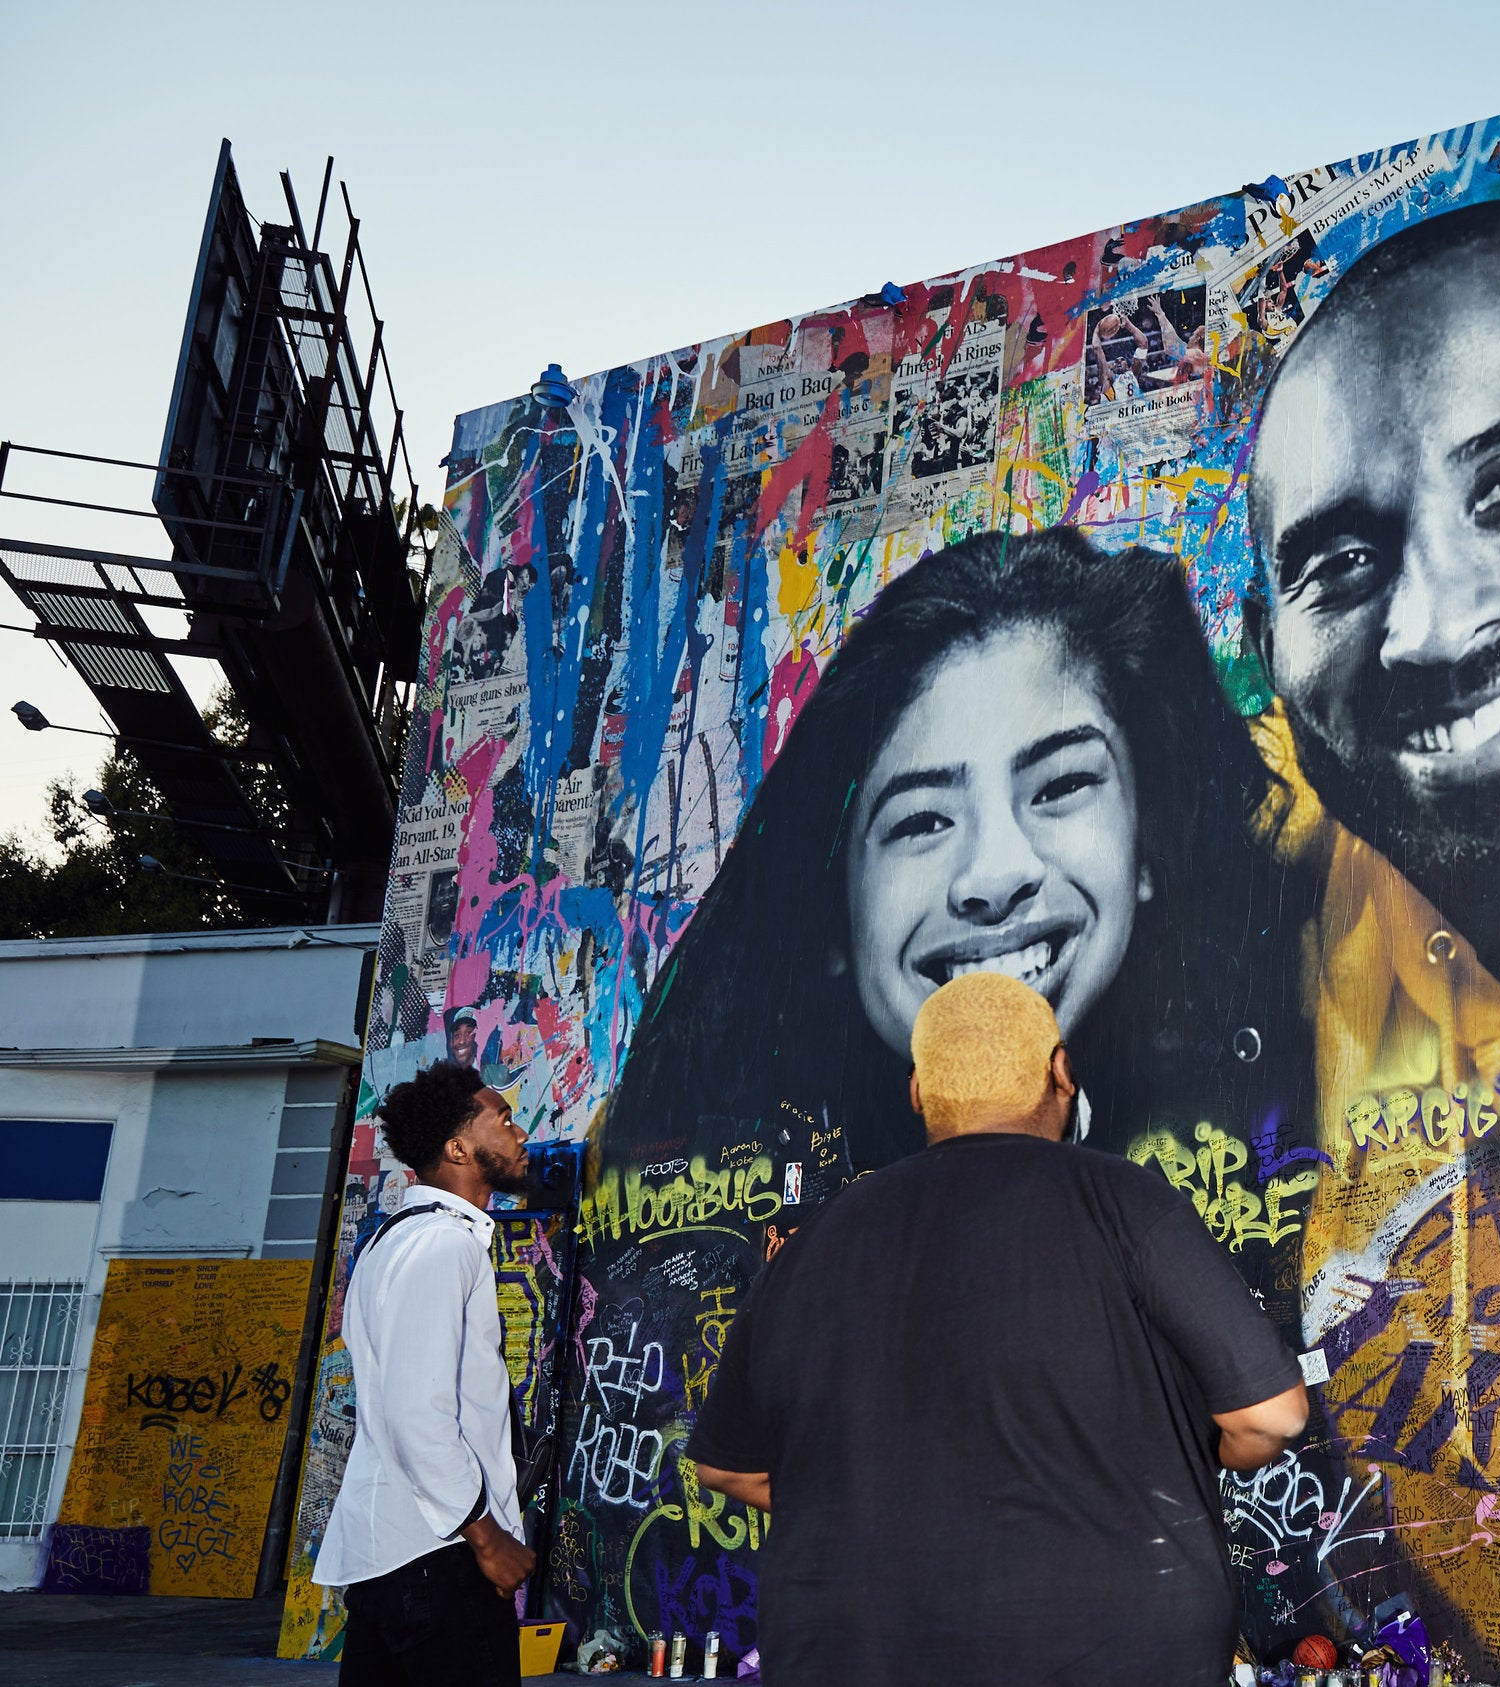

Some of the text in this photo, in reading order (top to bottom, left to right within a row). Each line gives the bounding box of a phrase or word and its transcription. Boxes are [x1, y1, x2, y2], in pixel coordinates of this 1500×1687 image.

[1366, 185, 1404, 216] come
[1405, 163, 1435, 192] true
[966, 342, 1003, 362] Rings
[899, 360, 934, 378] Three
[745, 375, 832, 411] Baq to Baq
[1118, 390, 1194, 418] 81 for the Book
[730, 442, 761, 463] Last
[563, 777, 583, 794] Air
[402, 799, 470, 825] Kid You Not
[399, 821, 457, 848] Bryant, 19,
[412, 845, 457, 867] All-Star
[144, 1268, 176, 1276] EXPRESS
[196, 1265, 220, 1273] SHOW
[196, 1273, 217, 1282] YOUR
[142, 1280, 176, 1288] YOURSELF
[194, 1282, 215, 1290] LOVE
[1301, 1269, 1327, 1305] KOBE
[581, 1321, 664, 1419] RIP
[1441, 1389, 1498, 1410] MAMBA
[169, 1434, 204, 1460] WE
[163, 1483, 231, 1523] KOBE
[159, 1519, 237, 1560] GIGI
